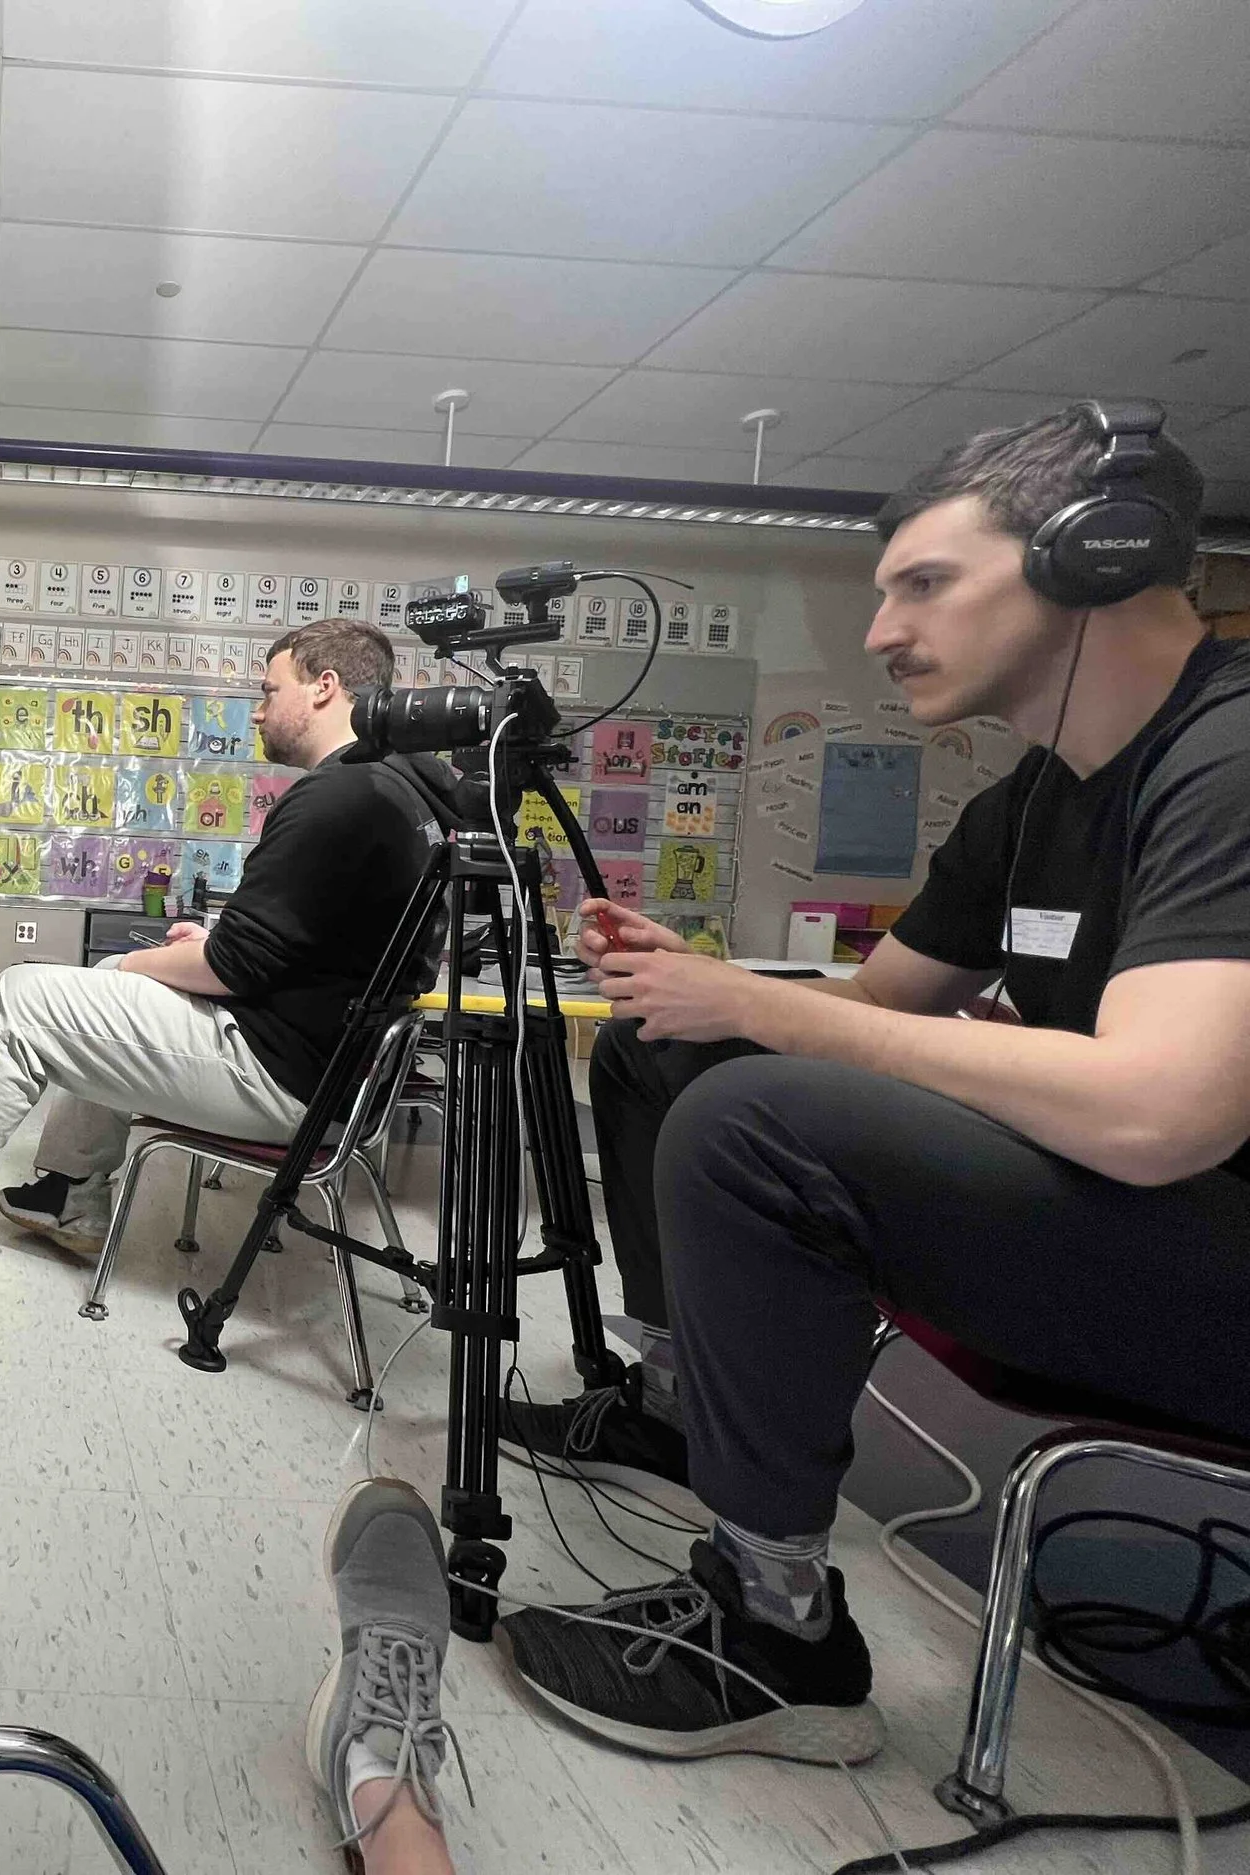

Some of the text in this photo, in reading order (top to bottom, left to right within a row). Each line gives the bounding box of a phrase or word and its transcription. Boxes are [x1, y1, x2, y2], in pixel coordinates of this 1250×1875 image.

[1082, 539, 1150, 549] TASCAM
[13, 564, 21, 575] 3
[54, 567, 62, 578] 4
[97, 570, 104, 581] 5
[138, 572, 146, 583] 6
[180, 575, 188, 586] 7
[222, 578, 230, 588] 8
[264, 579, 271, 591] 9
[304, 582, 314, 593] 10
[347, 585, 354, 595] 11
[386, 588, 397, 598] 12
[551, 599, 561, 609] 16
[592, 601, 602, 611] 17
[633, 604, 643, 614] 18
[673, 606, 684, 617] 19
[714, 609, 726, 618] 20
[11, 631, 25, 643] Ff
[63, 636, 79, 648] Hh
[147, 640, 163, 651] Kk
[257, 647, 267, 658] O
[16, 707, 29, 725] e
[72, 700, 103, 733] th
[132, 699, 171, 733] sh
[657, 719, 744, 750] Secret
[651, 743, 743, 770] Stories
[676, 781, 708, 796] am
[676, 801, 702, 815] an
[199, 811, 223, 828] or
[118, 857, 130, 869] G
